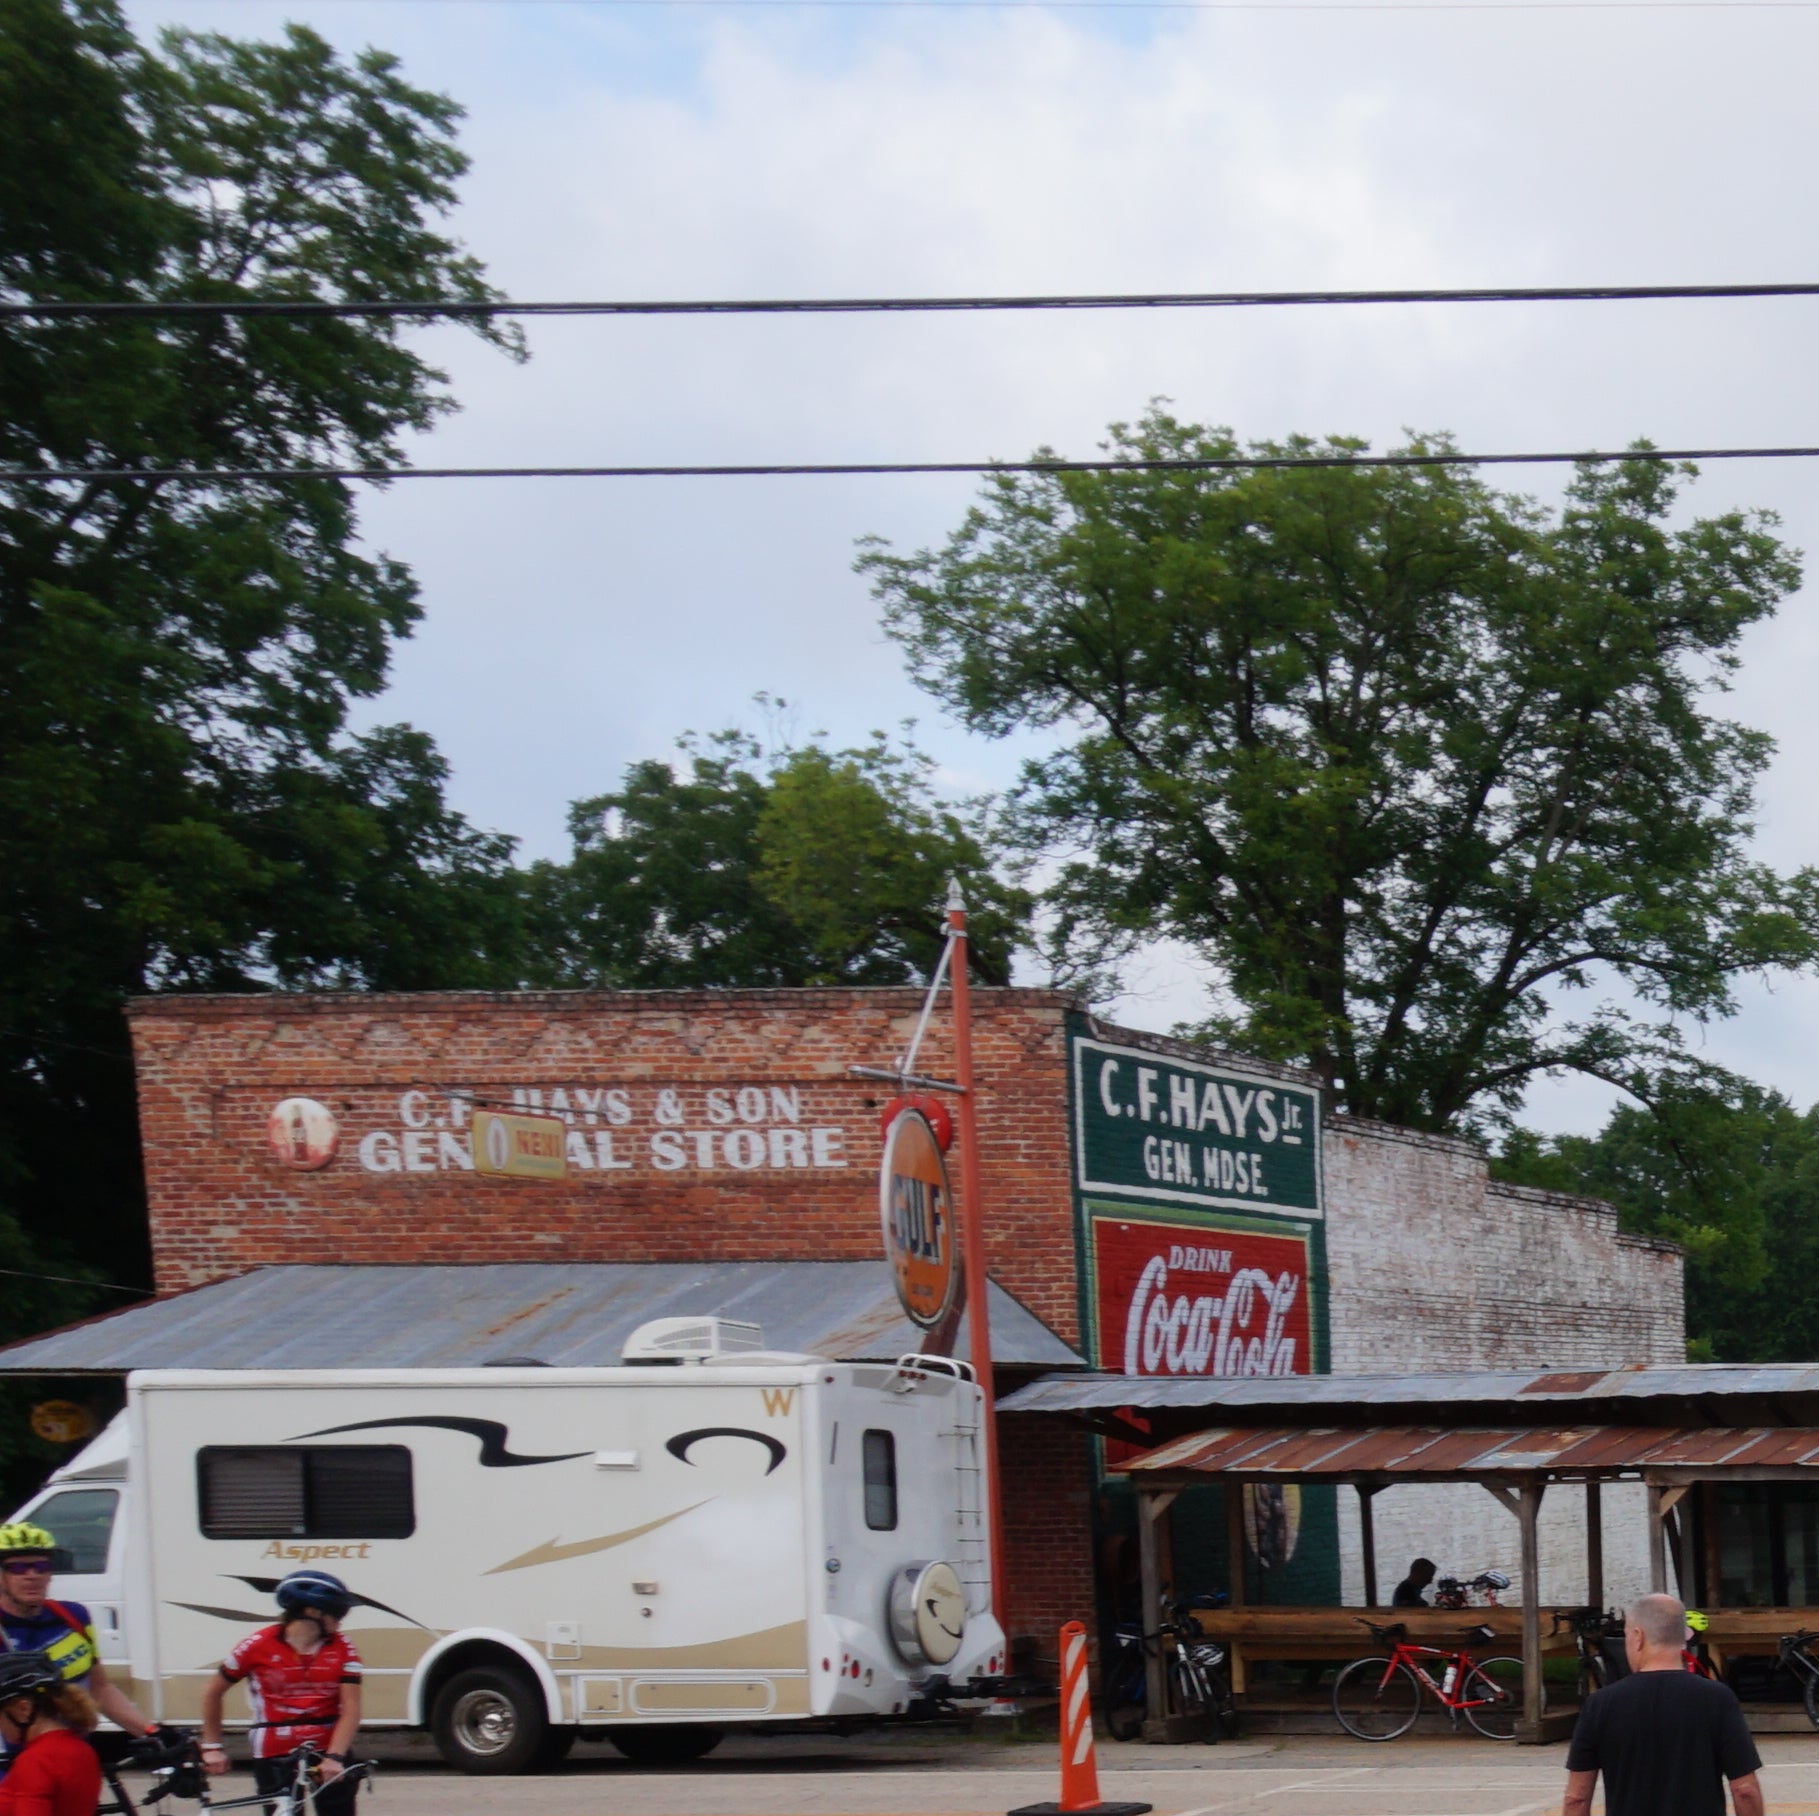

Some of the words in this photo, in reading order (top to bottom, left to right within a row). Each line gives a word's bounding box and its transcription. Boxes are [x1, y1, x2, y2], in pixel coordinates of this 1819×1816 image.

[654, 1087, 685, 1125] &
[705, 1086, 800, 1124] SON
[359, 1130, 633, 1172] GENAL
[650, 1128, 849, 1170] STORE
[1143, 1135, 1198, 1187] GEN.
[1203, 1146, 1269, 1197] MDSE.
[890, 1173, 947, 1266] GULF
[1167, 1245, 1233, 1273] DRINK
[260, 1540, 372, 1563] Aspect
